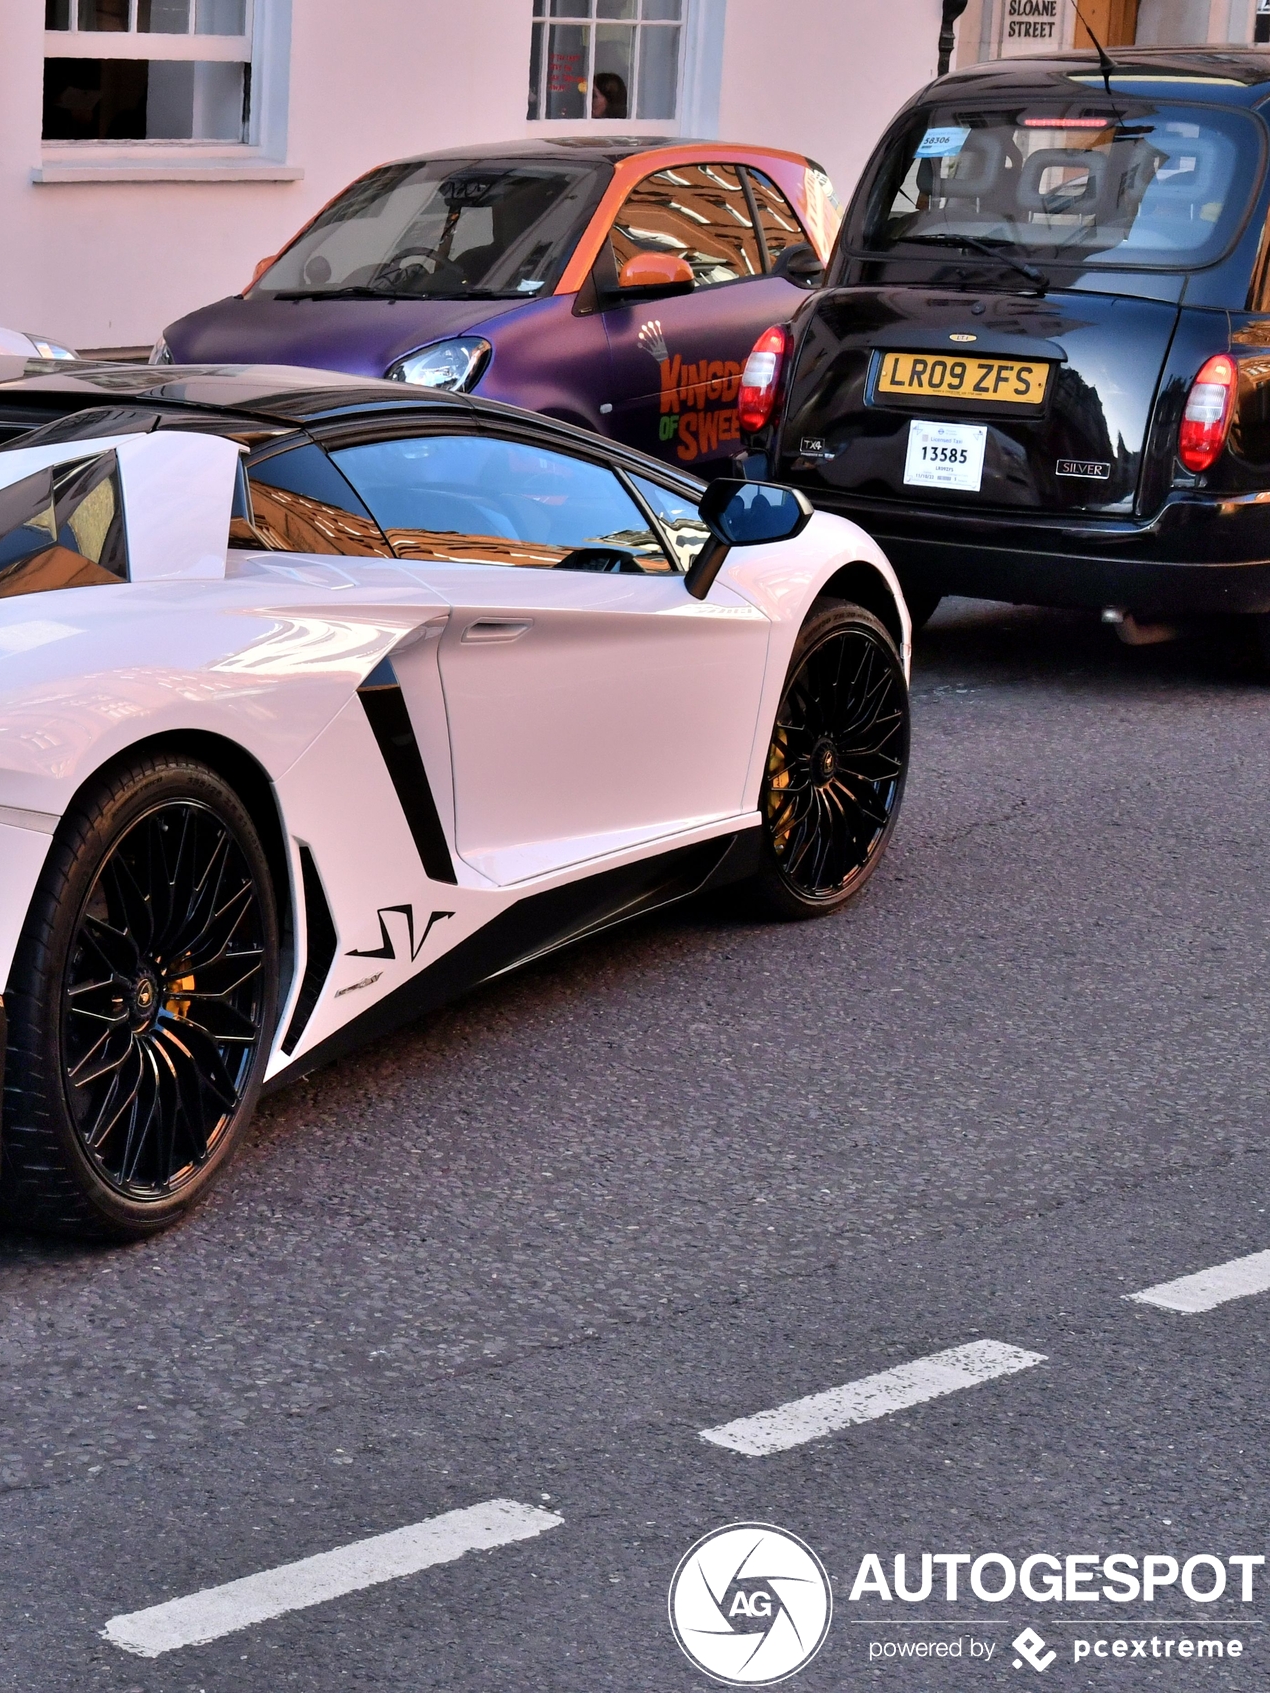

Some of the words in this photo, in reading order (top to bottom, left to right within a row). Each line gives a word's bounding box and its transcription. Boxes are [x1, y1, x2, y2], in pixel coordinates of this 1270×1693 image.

[1008, 0, 1057, 17] SLOANE
[1008, 21, 1055, 38] STREET
[923, 136, 951, 145] 58306
[660, 354, 748, 414] KINGD
[889, 357, 967, 390] LR09
[972, 363, 1034, 396] ZFS
[659, 415, 680, 441] OF
[803, 439, 823, 450] TX4
[930, 436, 952, 444] Licensed
[921, 446, 968, 464] 13585
[1062, 462, 1103, 475] SILVER
